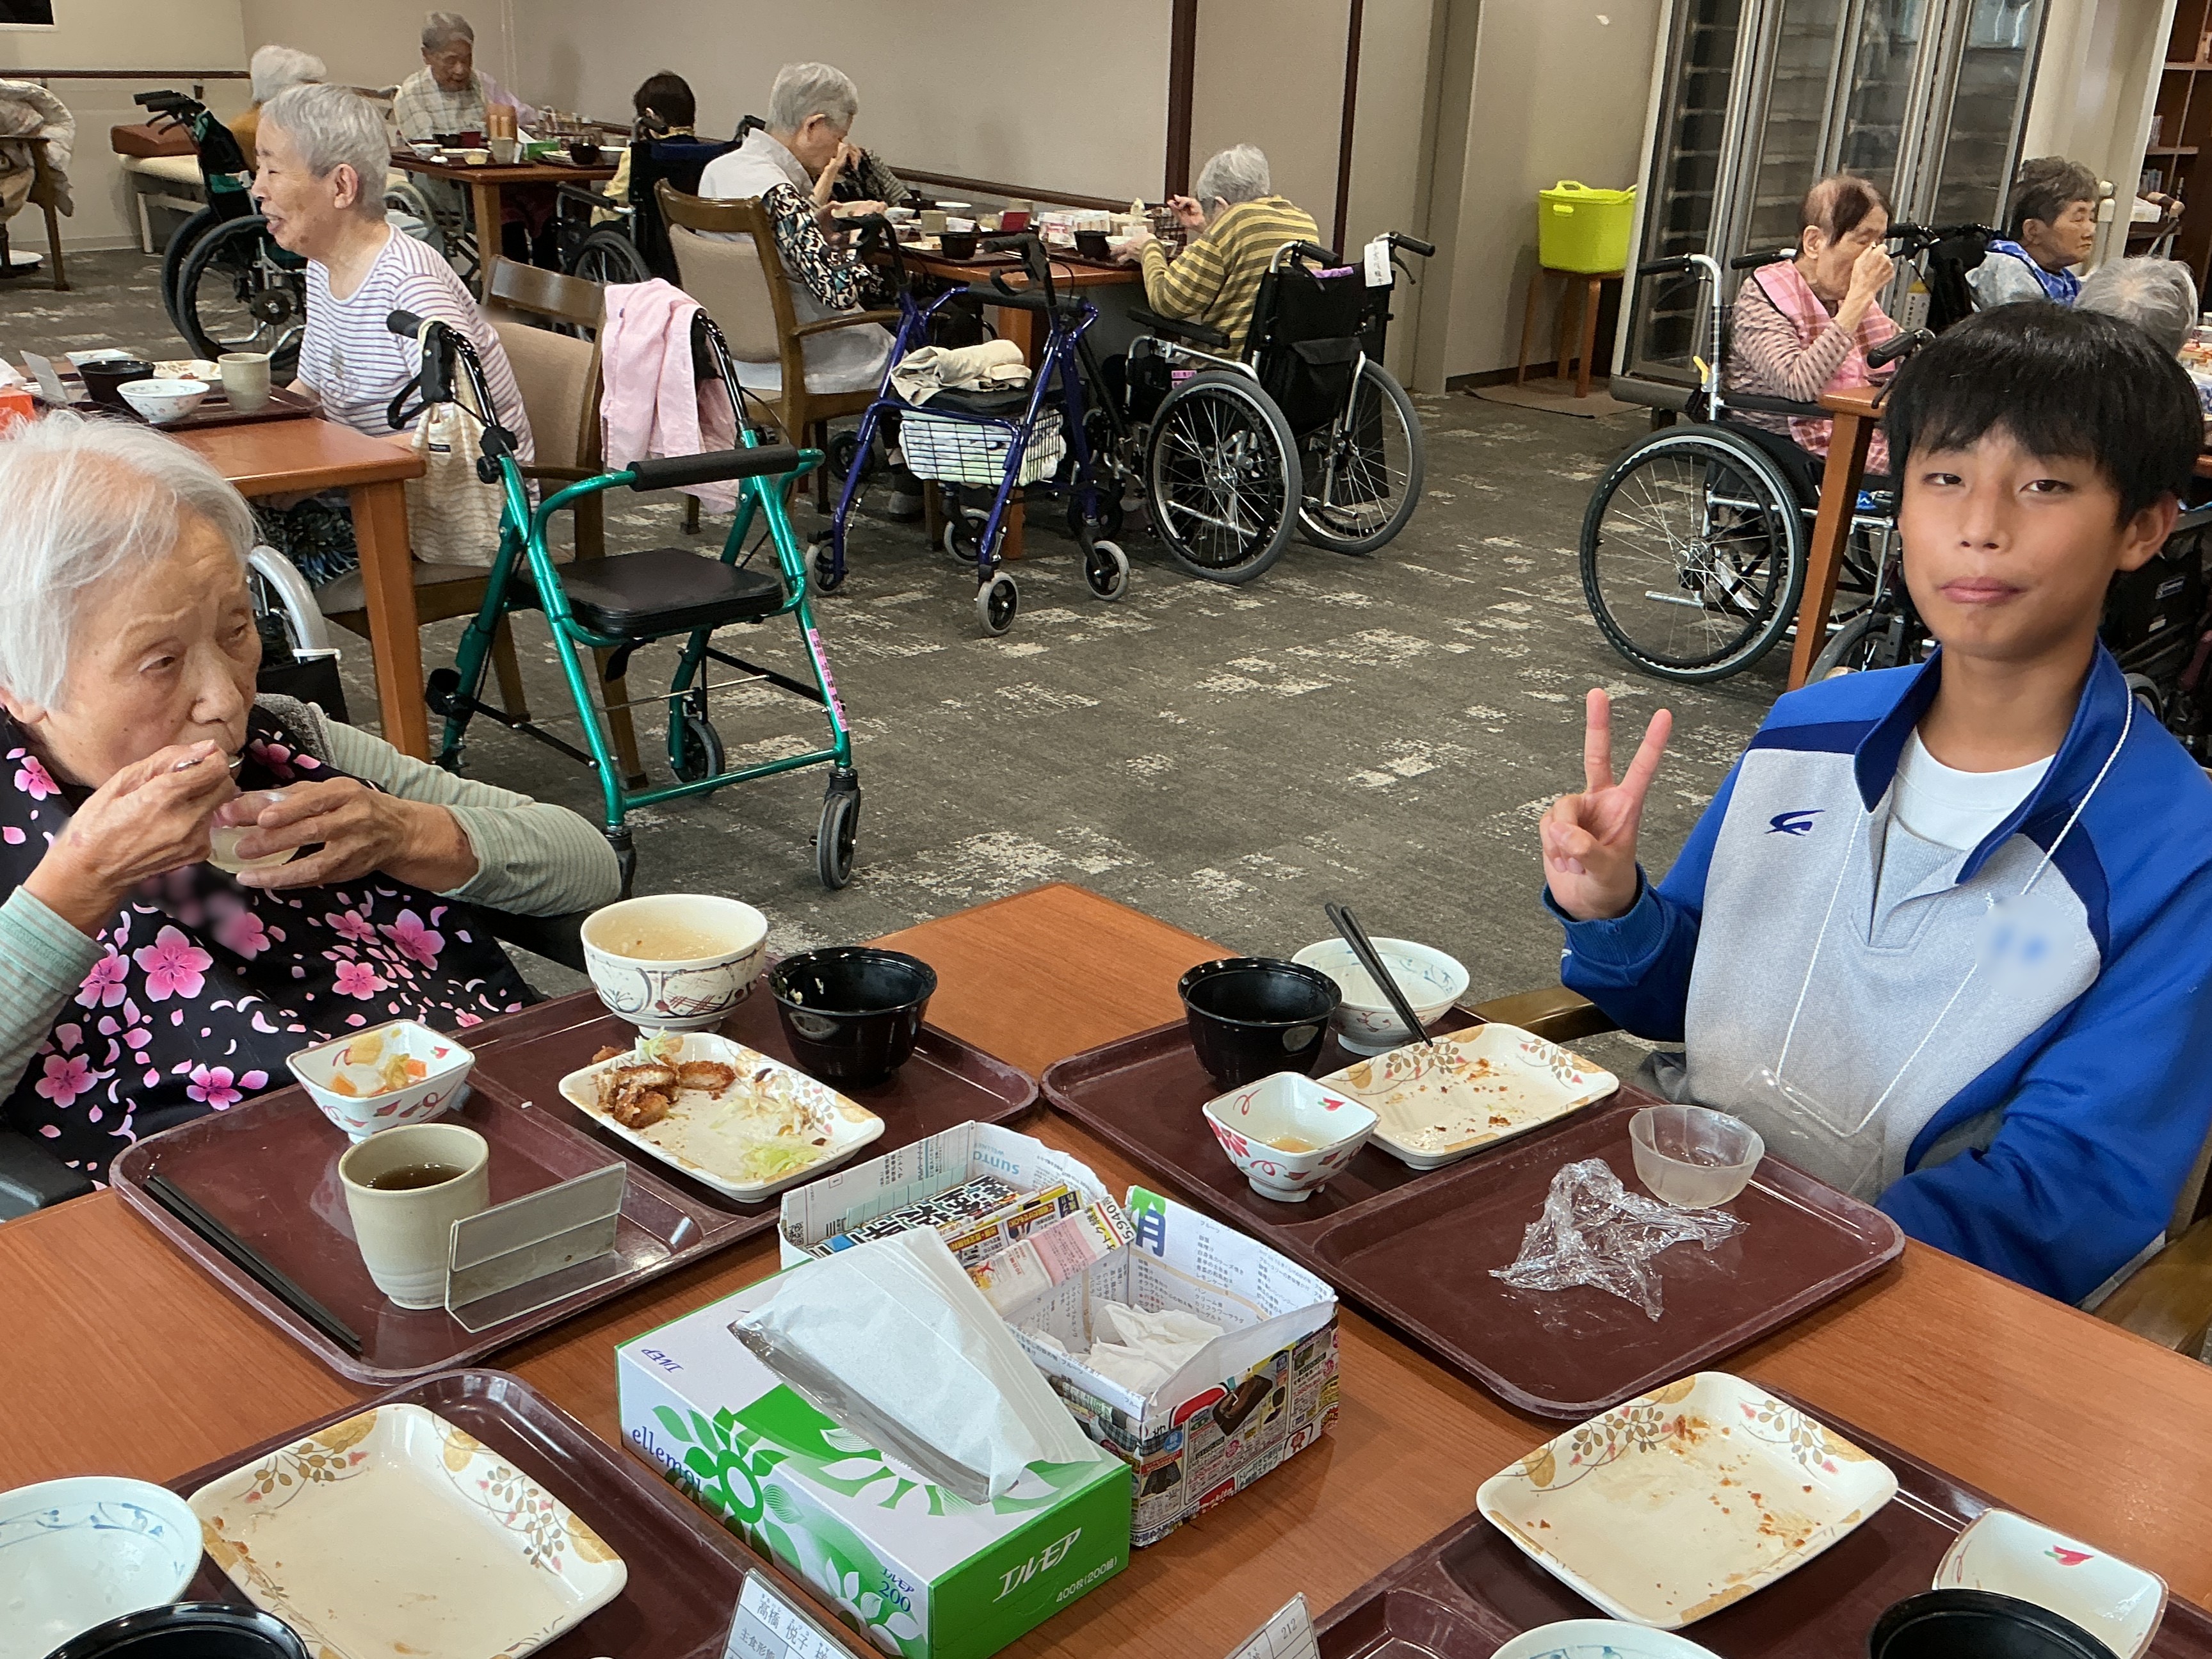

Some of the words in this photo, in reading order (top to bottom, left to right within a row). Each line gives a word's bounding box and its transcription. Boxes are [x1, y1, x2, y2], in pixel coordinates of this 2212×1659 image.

[641, 1348, 684, 1373] エルモア
[992, 1526, 1083, 1604] エルモア
[880, 1567, 915, 1594] エルモア
[878, 1580, 912, 1613] 200
[1280, 1618, 1298, 1640] 212
